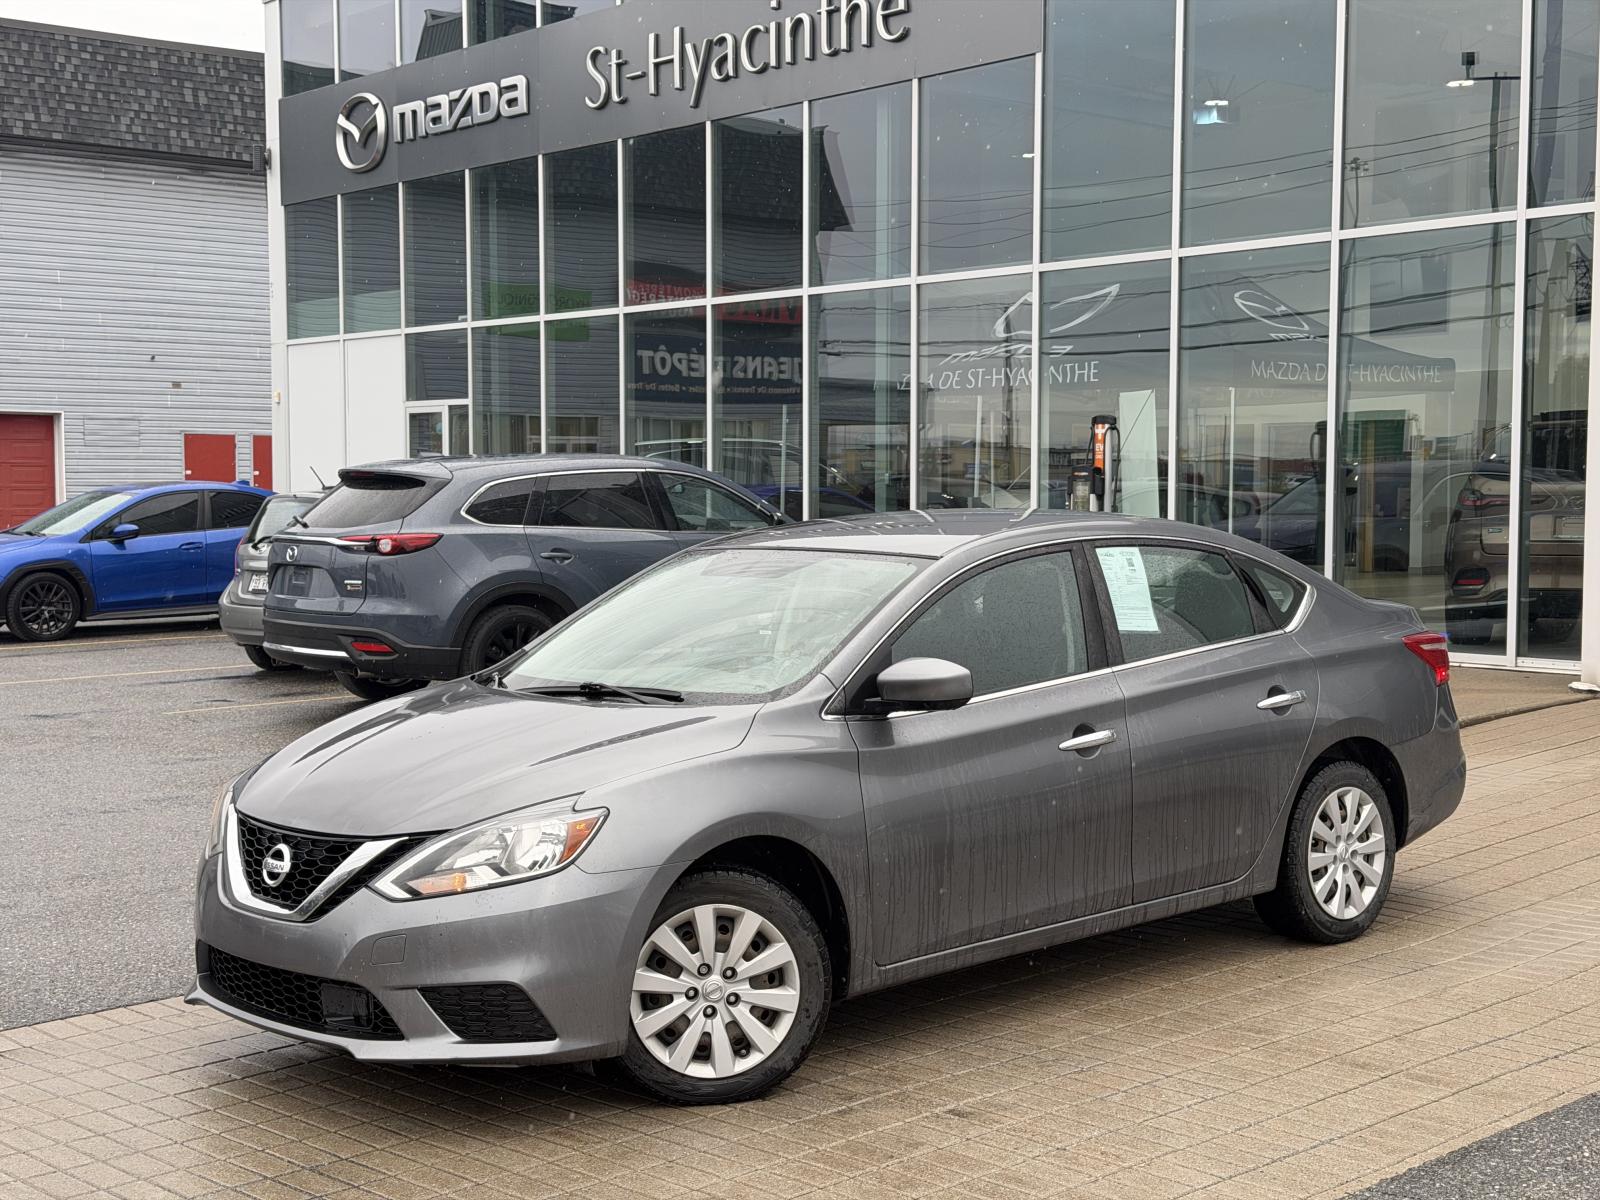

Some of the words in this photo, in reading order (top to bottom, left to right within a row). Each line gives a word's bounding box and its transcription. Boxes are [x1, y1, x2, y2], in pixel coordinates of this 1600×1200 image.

[392, 73, 530, 144] mazda
[583, 0, 911, 109] St-Hyacinthe
[966, 361, 1100, 389] ST-HYANTHE
[1250, 359, 1311, 381] MAZDA
[1345, 363, 1443, 384] T-HYACINTHE
